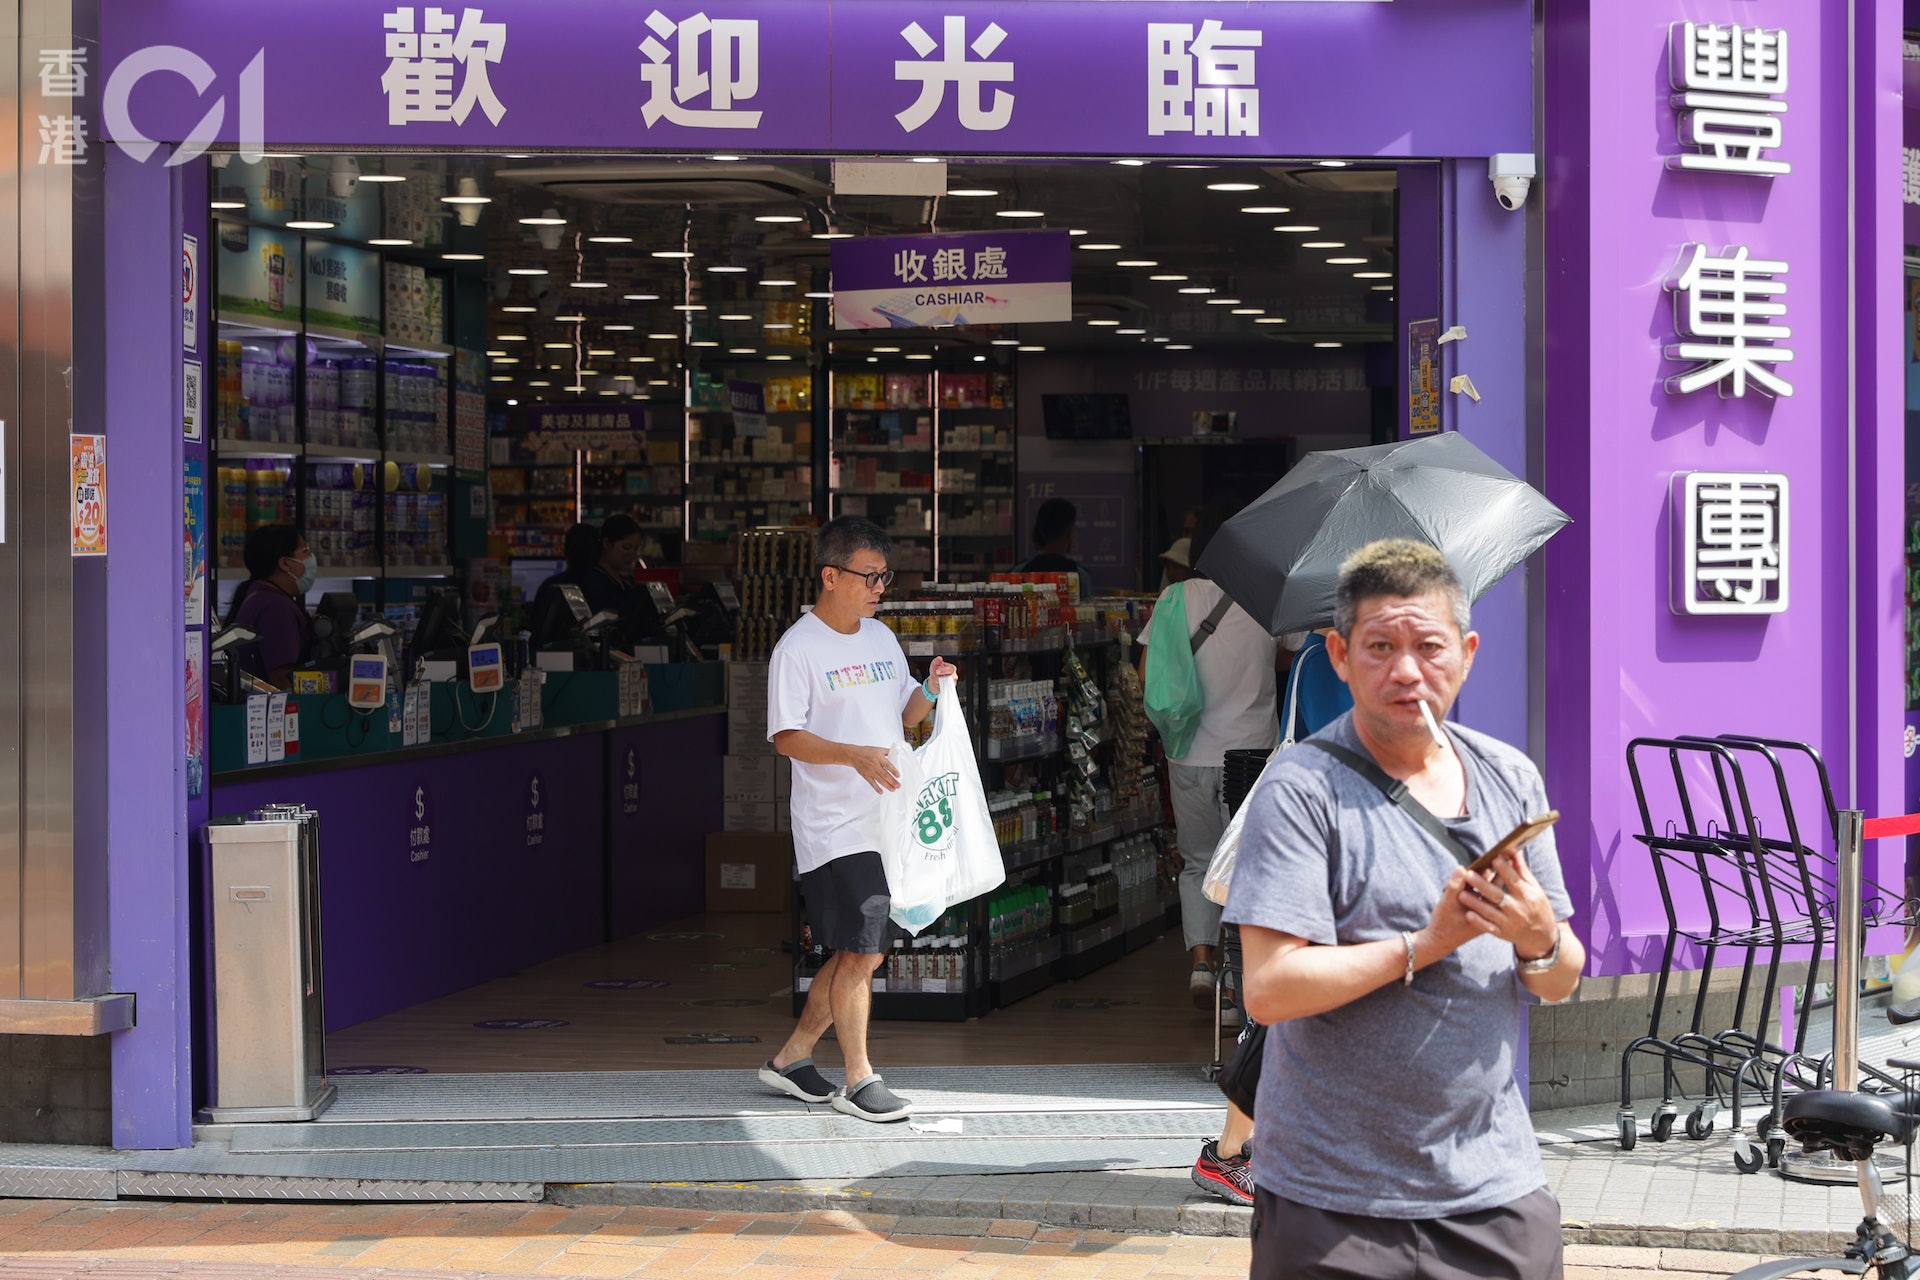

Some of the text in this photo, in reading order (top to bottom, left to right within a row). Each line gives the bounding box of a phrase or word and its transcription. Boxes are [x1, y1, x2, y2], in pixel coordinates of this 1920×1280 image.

[381, 7, 1263, 137] 歡迎光臨
[893, 246, 1008, 283] 收銀處
[915, 291, 985, 306] CASHIAR
[1678, 20, 1794, 616] 豐集團
[1027, 482, 1055, 497] 1/F
[410, 849, 430, 863] Cashier
